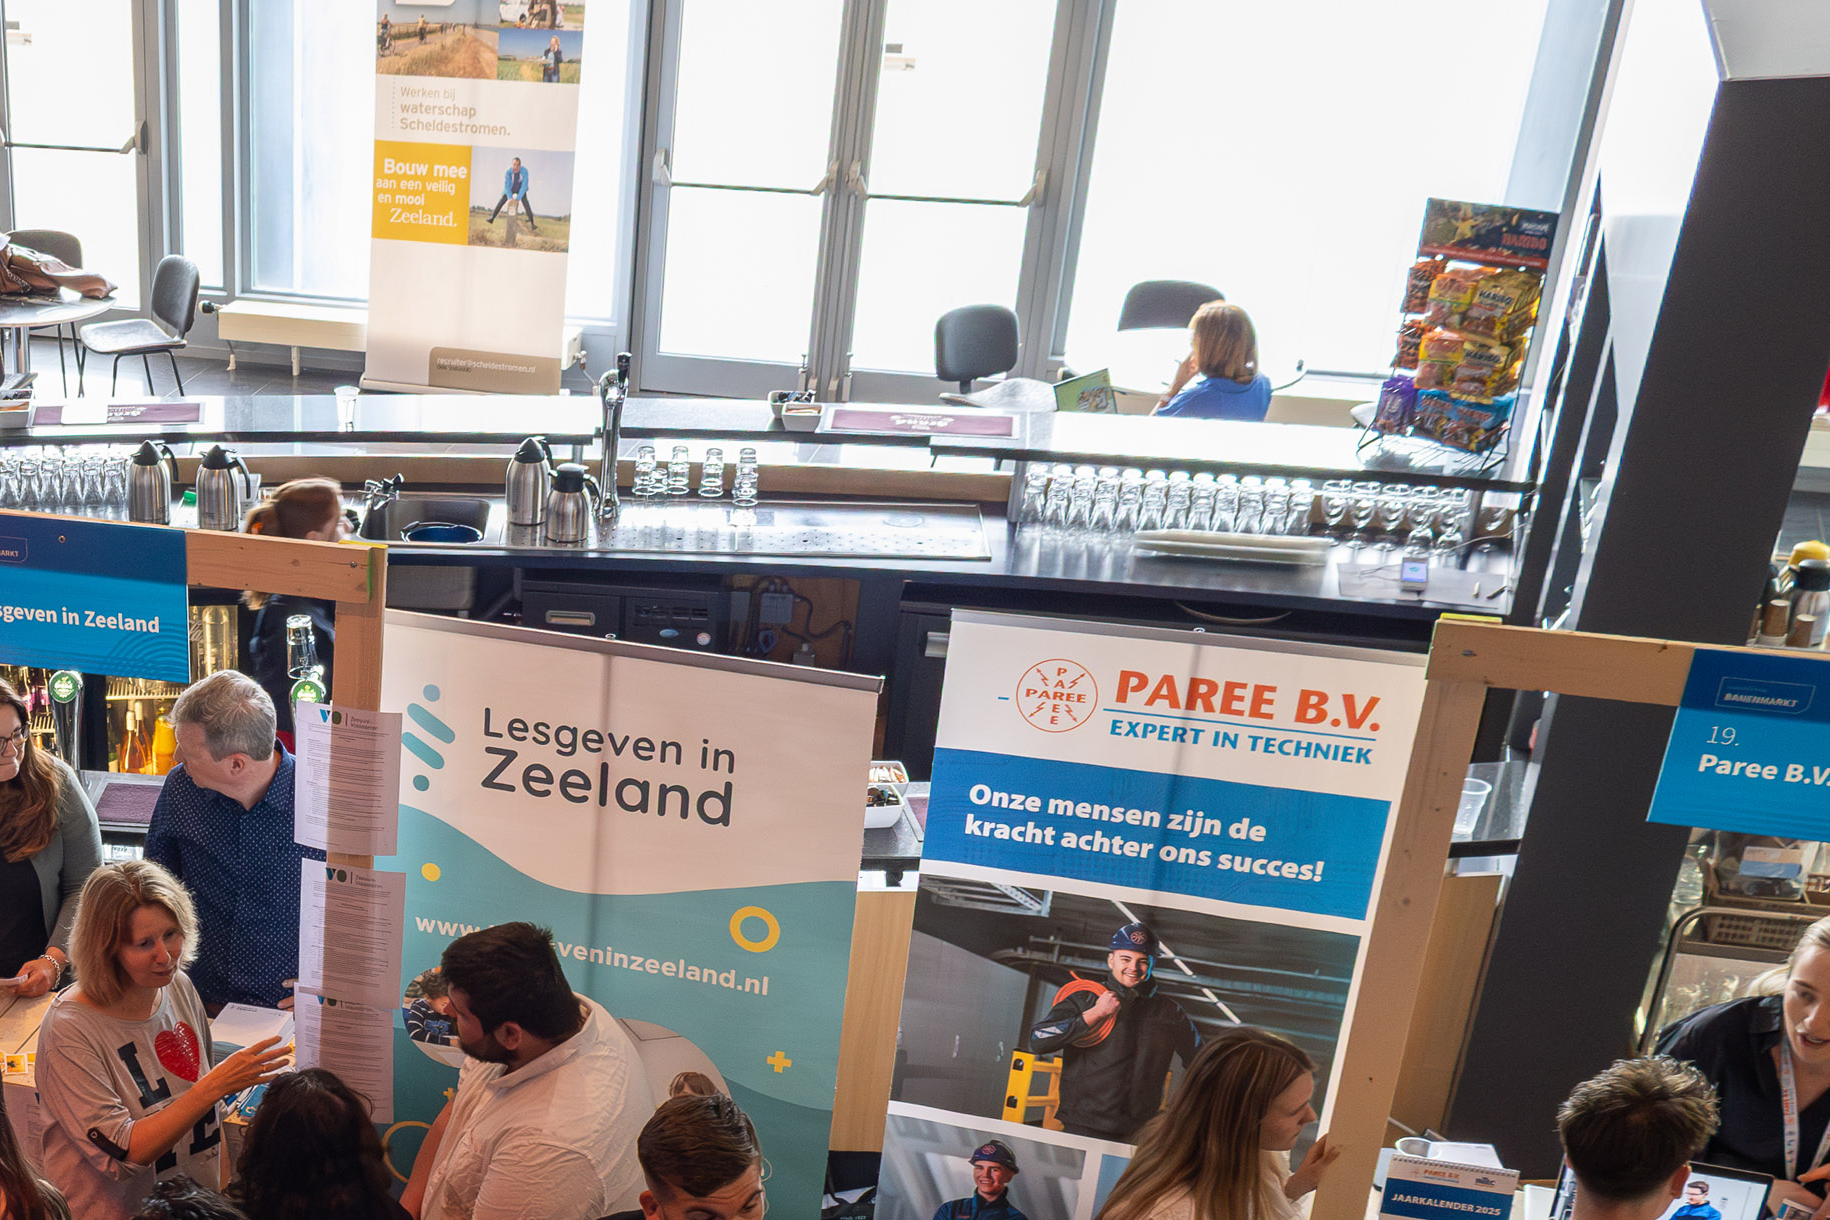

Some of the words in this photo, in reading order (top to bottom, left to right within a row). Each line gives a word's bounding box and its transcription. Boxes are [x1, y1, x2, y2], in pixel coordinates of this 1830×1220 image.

[401, 86, 440, 98] Werken
[444, 88, 456, 101] bij
[400, 103, 476, 119] waterschap
[400, 118, 511, 136] Scheldestromen.
[384, 158, 428, 176] Bouw
[434, 164, 467, 178] mee
[376, 178, 396, 189] aan
[400, 180, 422, 190] een
[426, 180, 455, 196] veilig
[378, 193, 391, 204] en
[396, 194, 425, 206] mooi
[390, 207, 457, 227] Zeeland.
[61, 607, 80, 625] in
[84, 610, 159, 633] Zeeland
[1025, 688, 1087, 704] PAREE
[1115, 669, 1277, 720] PAREE
[1294, 689, 1381, 732] B.V.
[484, 707, 682, 765] Lesgeven
[701, 739, 735, 774] in
[1110, 719, 1205, 745] EXPERT
[1212, 730, 1239, 750] IN
[1248, 734, 1373, 765] TECHNIEK
[1706, 726, 1739, 746] 19.
[1698, 753, 1778, 780] Paree
[481, 746, 732, 827] Zeeland
[969, 783, 1042, 812] Onze
[1047, 797, 1160, 829] mensen
[1167, 809, 1221, 838] zijn
[1229, 817, 1267, 842] de
[965, 813, 1055, 846] kracht
[1061, 827, 1153, 859] achter
[1158, 845, 1211, 867] ons
[1217, 852, 1325, 882] succes!
[1392, 1193, 1474, 1212] JAARKALENDER
[1474, 1205, 1501, 1216] 2025
